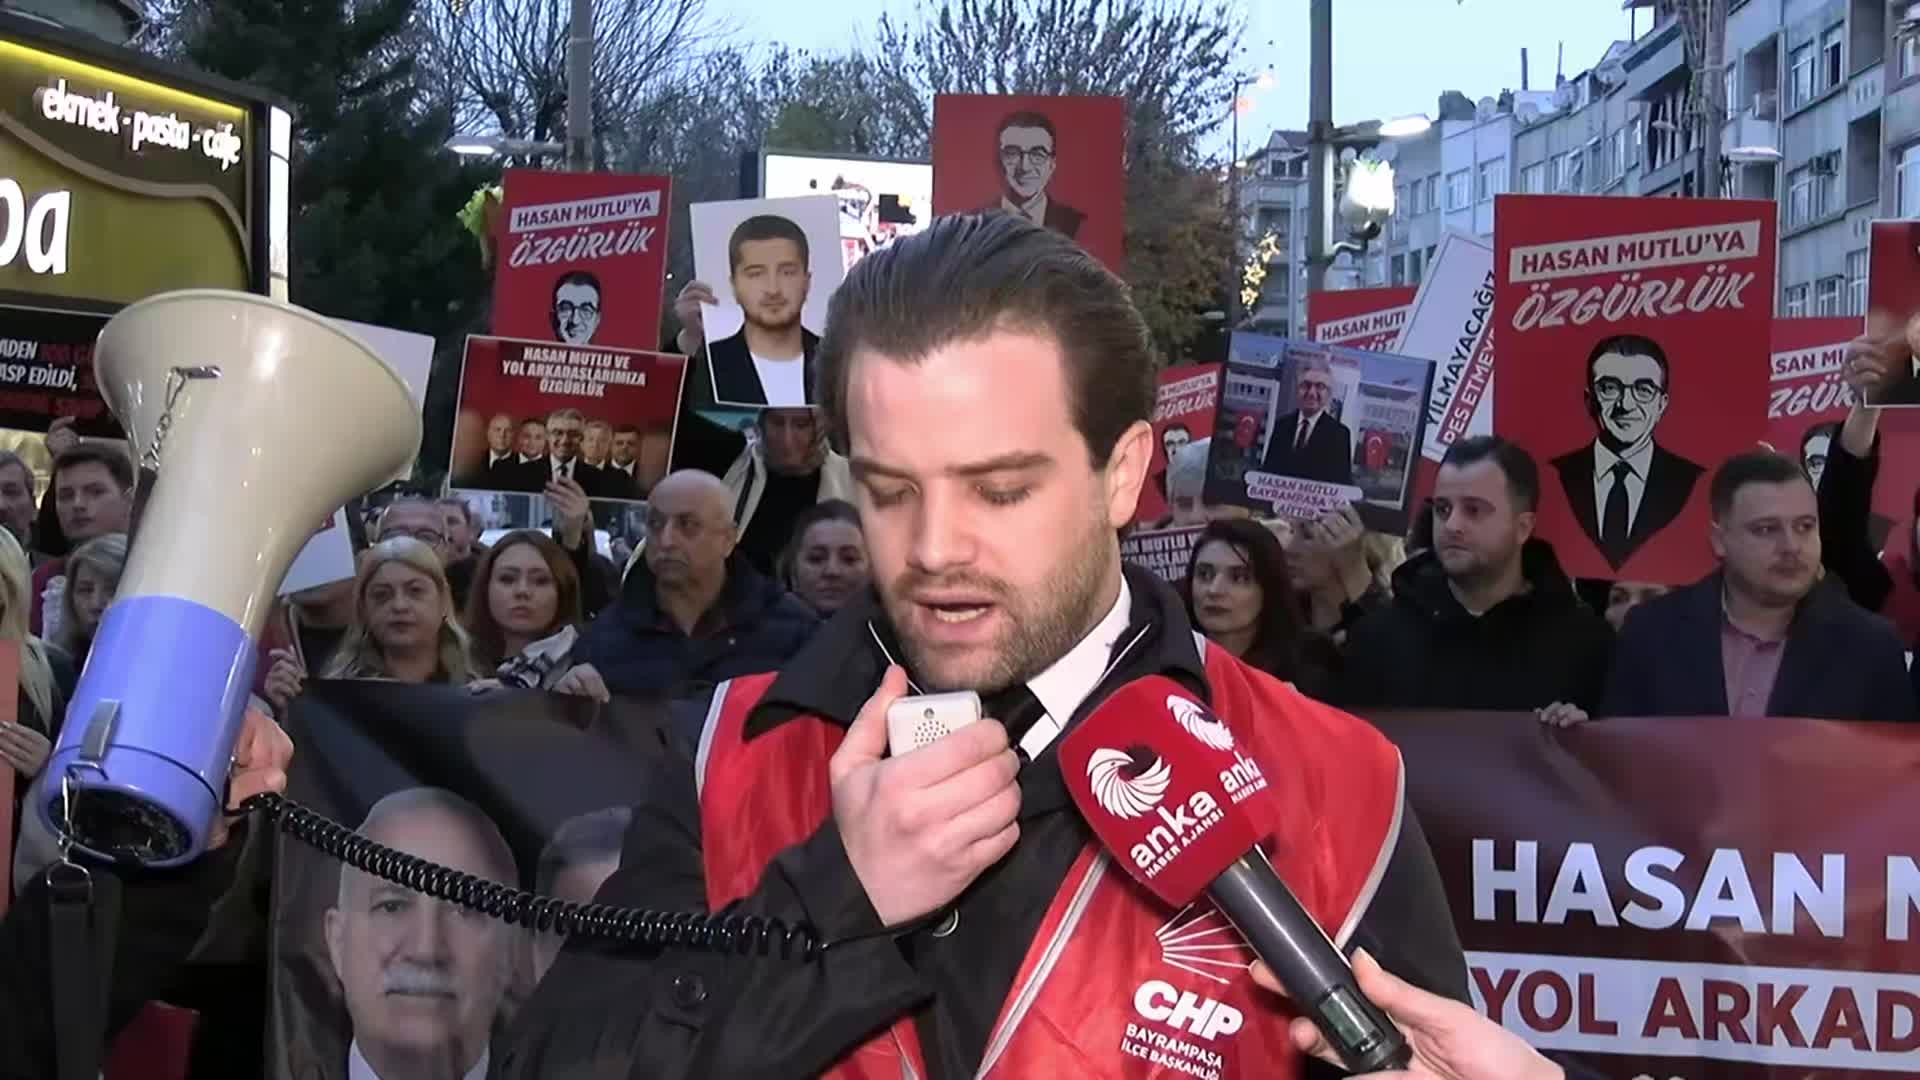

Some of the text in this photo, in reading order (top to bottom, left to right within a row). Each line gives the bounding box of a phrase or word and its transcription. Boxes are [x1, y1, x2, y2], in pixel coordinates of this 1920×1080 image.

[43, 79, 120, 134] ekmek
[132, 111, 190, 151] pasta
[517, 207, 572, 227] HASAN
[509, 221, 656, 268] ÖZGÜRLÜK
[1521, 229, 1745, 275] HASAN MUTLU'YA
[1512, 263, 1755, 332] ÖZGÜRLÜK
[1321, 319, 1369, 341] HASAN
[502, 359, 525, 376] YOL
[523, 347, 631, 370] HASAN MUTLU VE
[1257, 475, 1339, 496] HASAN MUTLU
[1130, 791, 1217, 868] anka
[1145, 808, 1224, 878] HABER AJANSI
[1472, 838, 1845, 938] HASAN
[1134, 980, 1243, 1041] CHP
[1470, 967, 1920, 1053] YOL ARKAD
[1121, 1037, 1149, 1059] İLÇE
[1125, 1022, 1222, 1069] BAYRAMPAŞA
